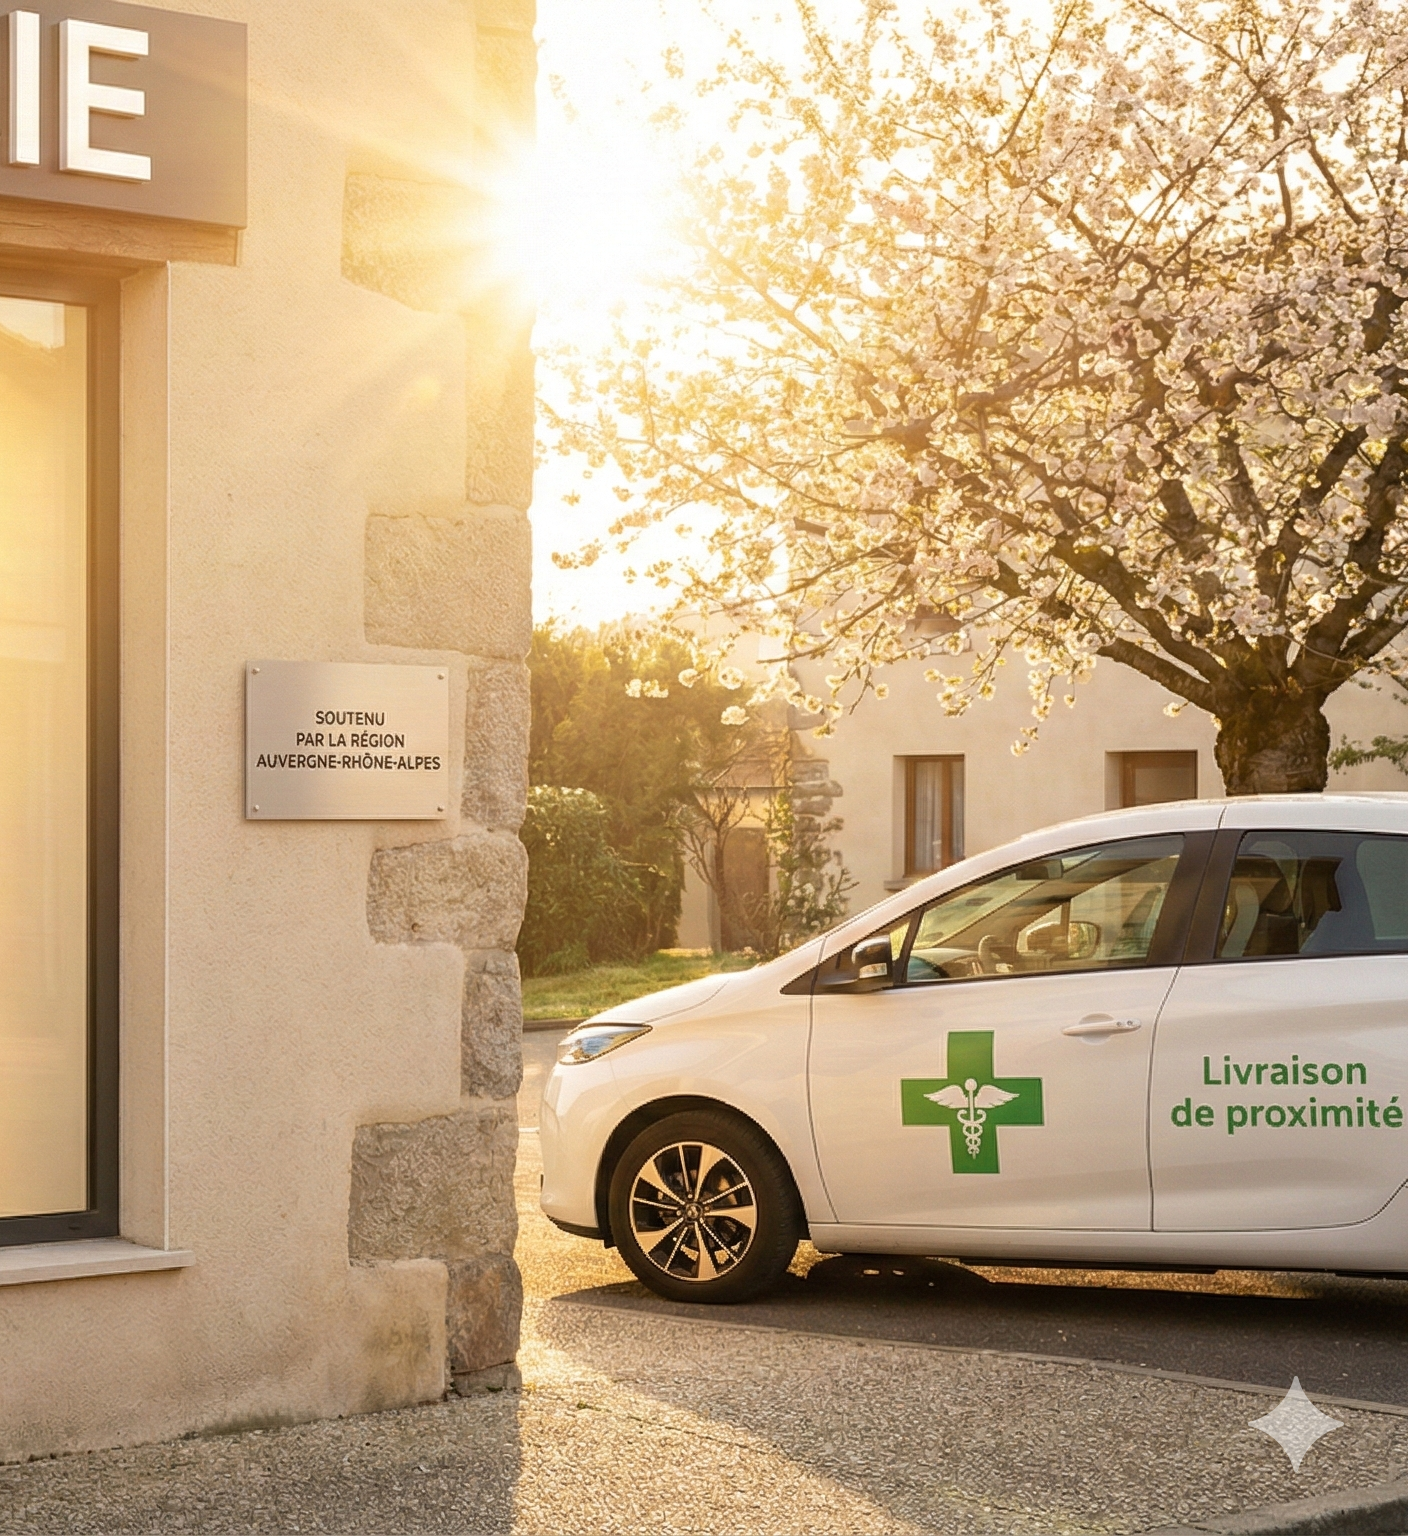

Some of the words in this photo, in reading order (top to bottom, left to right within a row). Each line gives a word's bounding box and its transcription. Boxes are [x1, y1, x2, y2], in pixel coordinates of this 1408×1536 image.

[315, 710, 385, 726] SOUTENU
[296, 732, 324, 747] PAR
[328, 733, 346, 747] LA
[351, 730, 405, 748] RÉGION
[256, 753, 441, 770] AUVERGNE-RHÔNE-ALPES
[1203, 1054, 1367, 1085] Livraison
[1171, 1097, 1214, 1127] de
[1227, 1096, 1403, 1135] proximité
